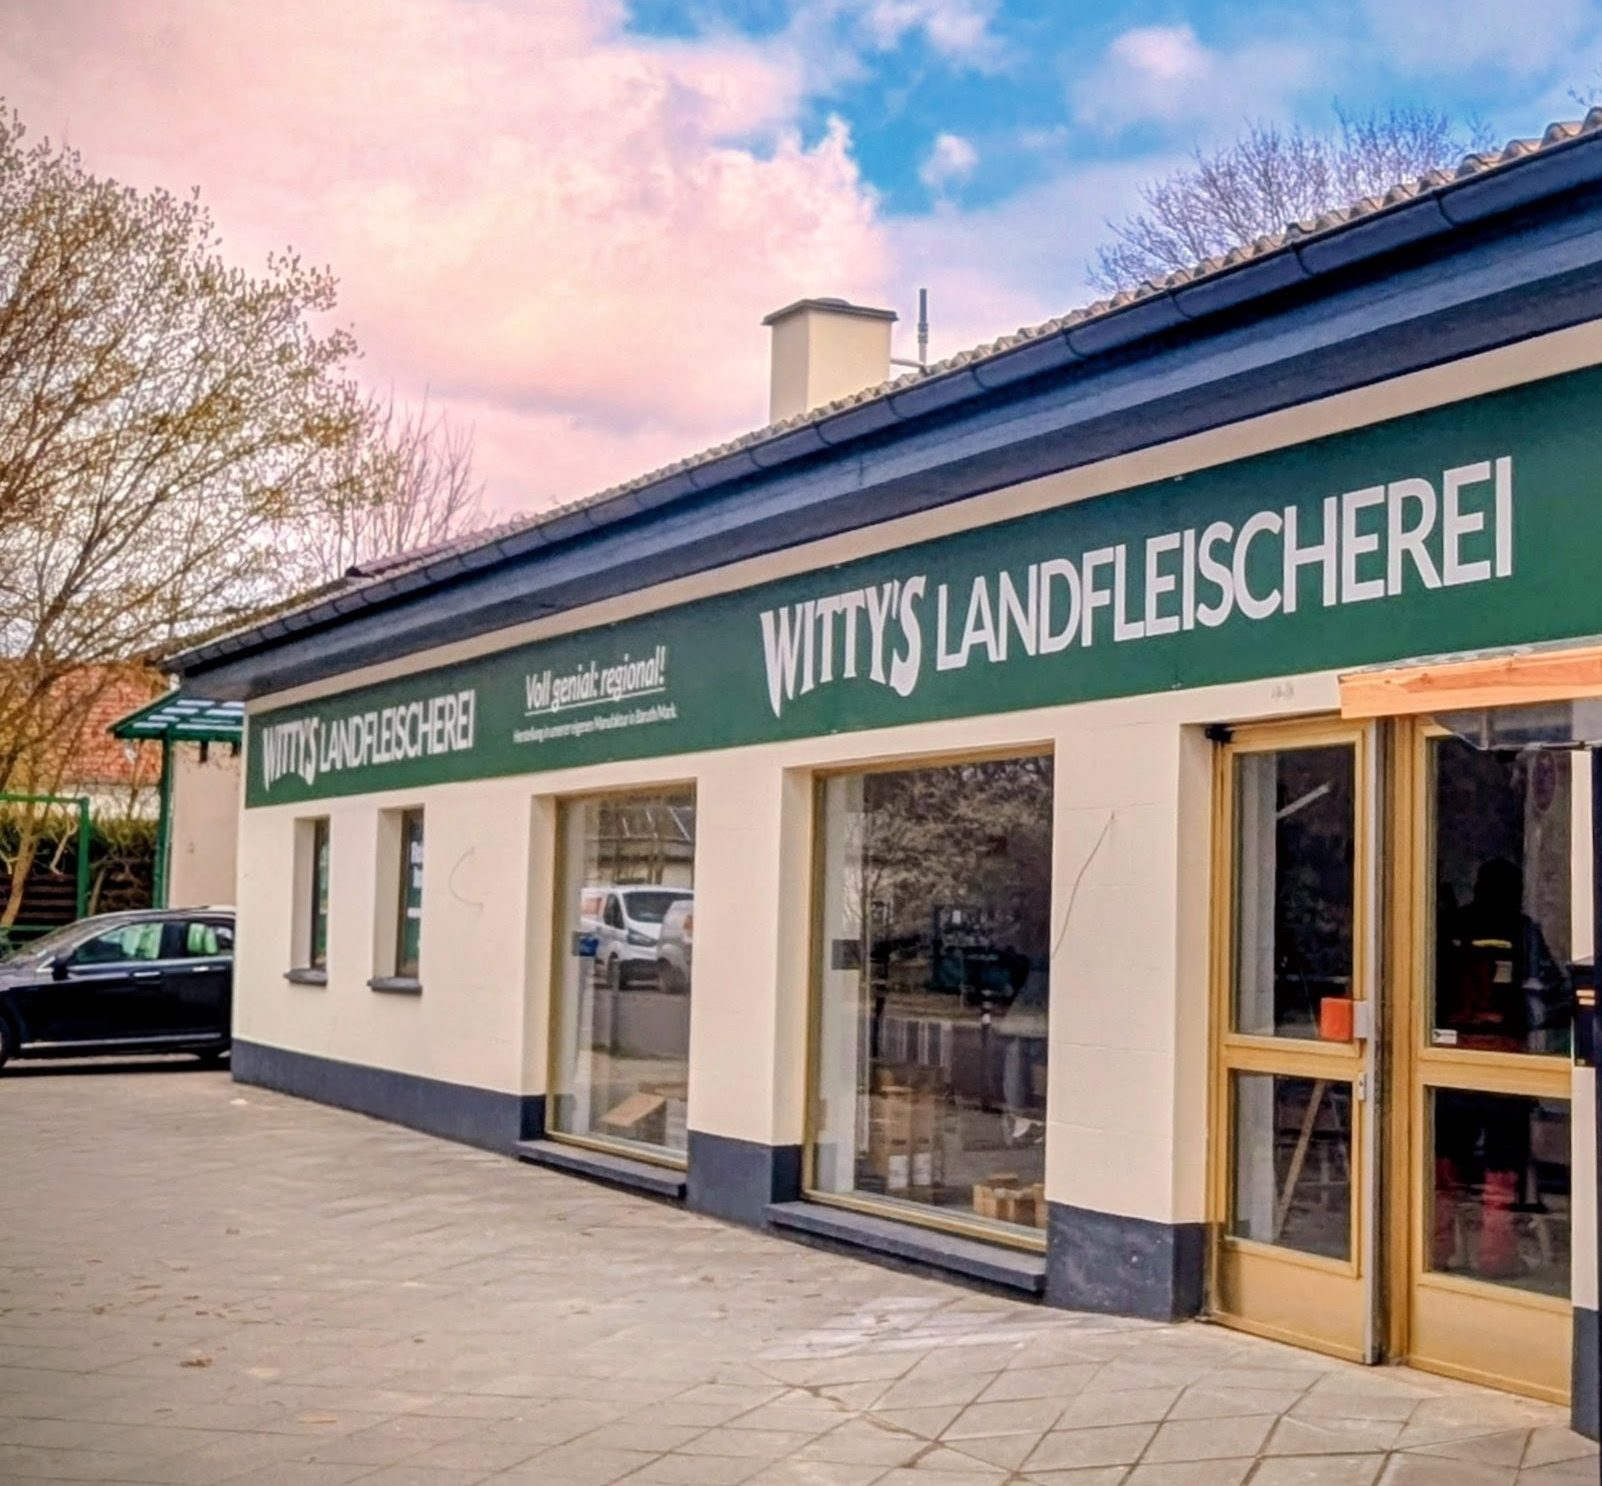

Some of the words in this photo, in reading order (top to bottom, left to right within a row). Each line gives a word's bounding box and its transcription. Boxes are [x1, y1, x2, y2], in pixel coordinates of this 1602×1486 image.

[759, 574, 927, 719] WITTY'S
[935, 455, 1513, 673] LANDFLEISCHEREI
[525, 670, 552, 710] Voll
[551, 660, 599, 713] genial:
[600, 645, 667, 702] regional!
[320, 689, 476, 773] LANDFLEISCHEREI
